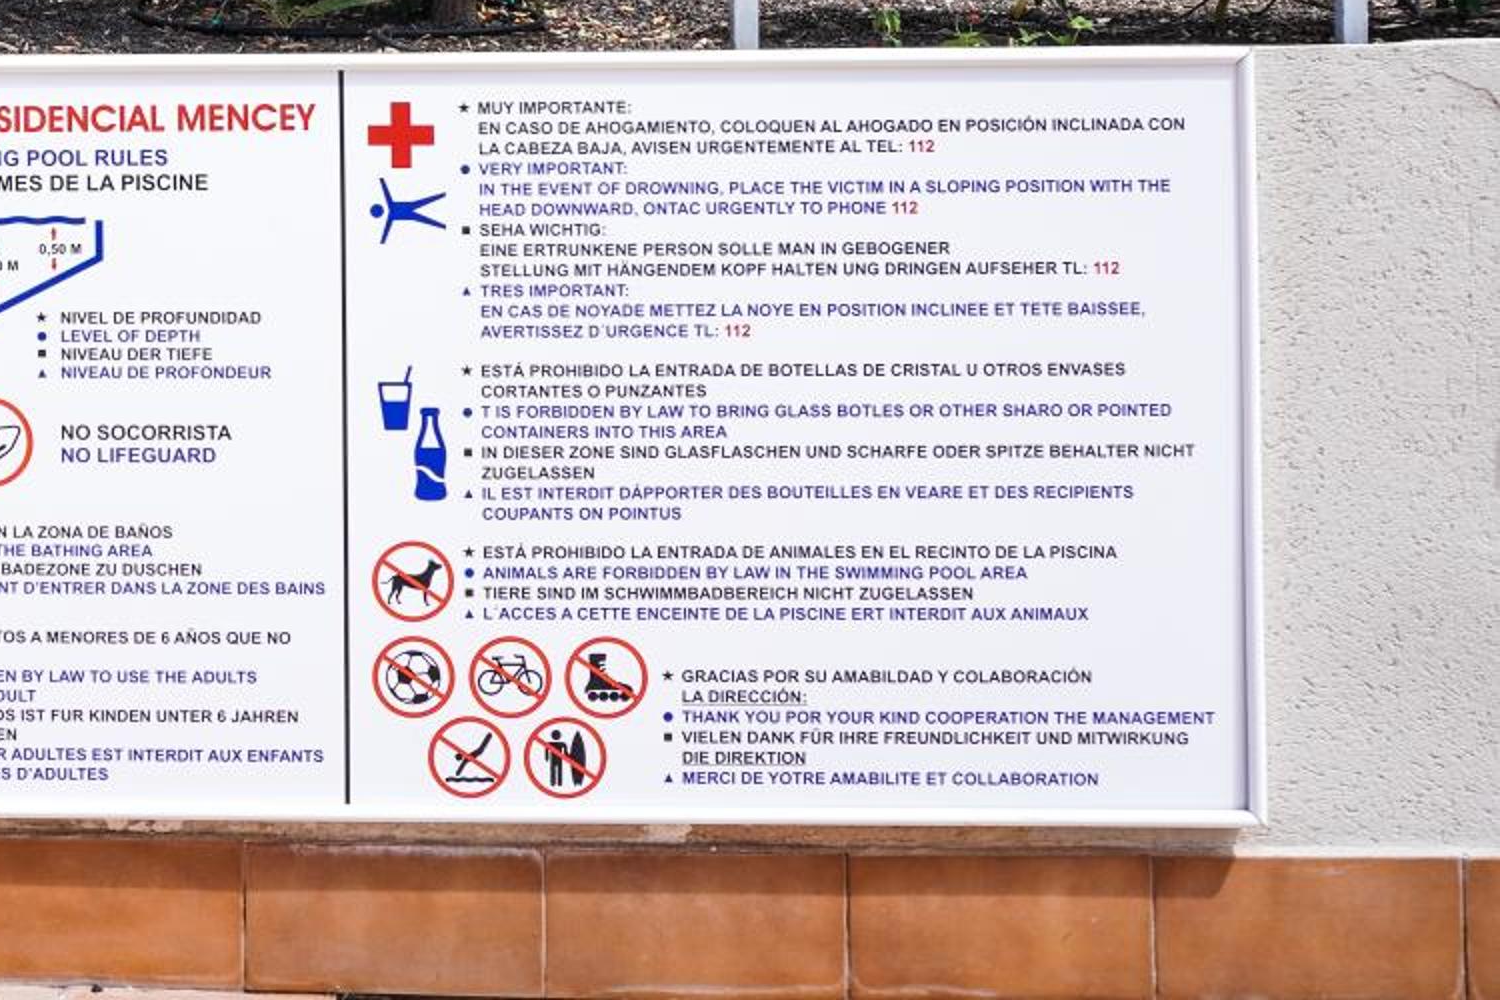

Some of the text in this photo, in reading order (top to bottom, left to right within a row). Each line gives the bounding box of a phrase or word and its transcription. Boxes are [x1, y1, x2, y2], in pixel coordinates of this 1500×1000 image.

[477, 100, 631, 114] MUY IMPORTANTE:
[177, 103, 316, 132] MENCEY
[478, 116, 1185, 135] EN CASO DE AHOGAMIENTO, COLOQUEN AL AHOGADO EN POSICIÓN INCLINADA CON
[27, 149, 88, 166] POOL
[94, 148, 168, 166] RULES
[478, 161, 627, 176] VERY IMPORTANT:
[49, 174, 79, 191] DE
[86, 174, 115, 191] LA
[121, 173, 208, 191] PISCINE
[38, 243, 82, 255] 0,50 M
[7, 260, 18, 271] M
[60, 311, 261, 324] NIVEL DE PROFUNDIDAD
[61, 329, 200, 342] LEVEL OF DEPTH
[61, 347, 212, 360] NIVEAU DER TIEFE
[61, 365, 271, 379] NIVEAU DE PROFONDEUR
[481, 383, 706, 398] CORTANTES O PUNZANTES
[61, 424, 232, 440] NO SOCORRISTA
[481, 425, 727, 438] CONTAINERS INTO THIS AREA
[61, 447, 216, 463] NO LIFEGUARD
[13, 525, 33, 538] LA
[37, 525, 83, 539] ZONA
[87, 525, 109, 538] DE
[114, 523, 172, 538] BAÑOS
[31, 543, 102, 557] BATHING
[107, 543, 152, 557] AREA
[483, 565, 1028, 580] ANIMALS ARE FORBIDDEN BY LAW IN THE SWIMMING POOL AREA
[681, 667, 1092, 684] GRACIAS POR SU AMABILDAD Y COLABORACIÓN
[681, 688, 808, 705] LA DIRECCIÓN:
[682, 751, 807, 766] DIE DIREKTION
